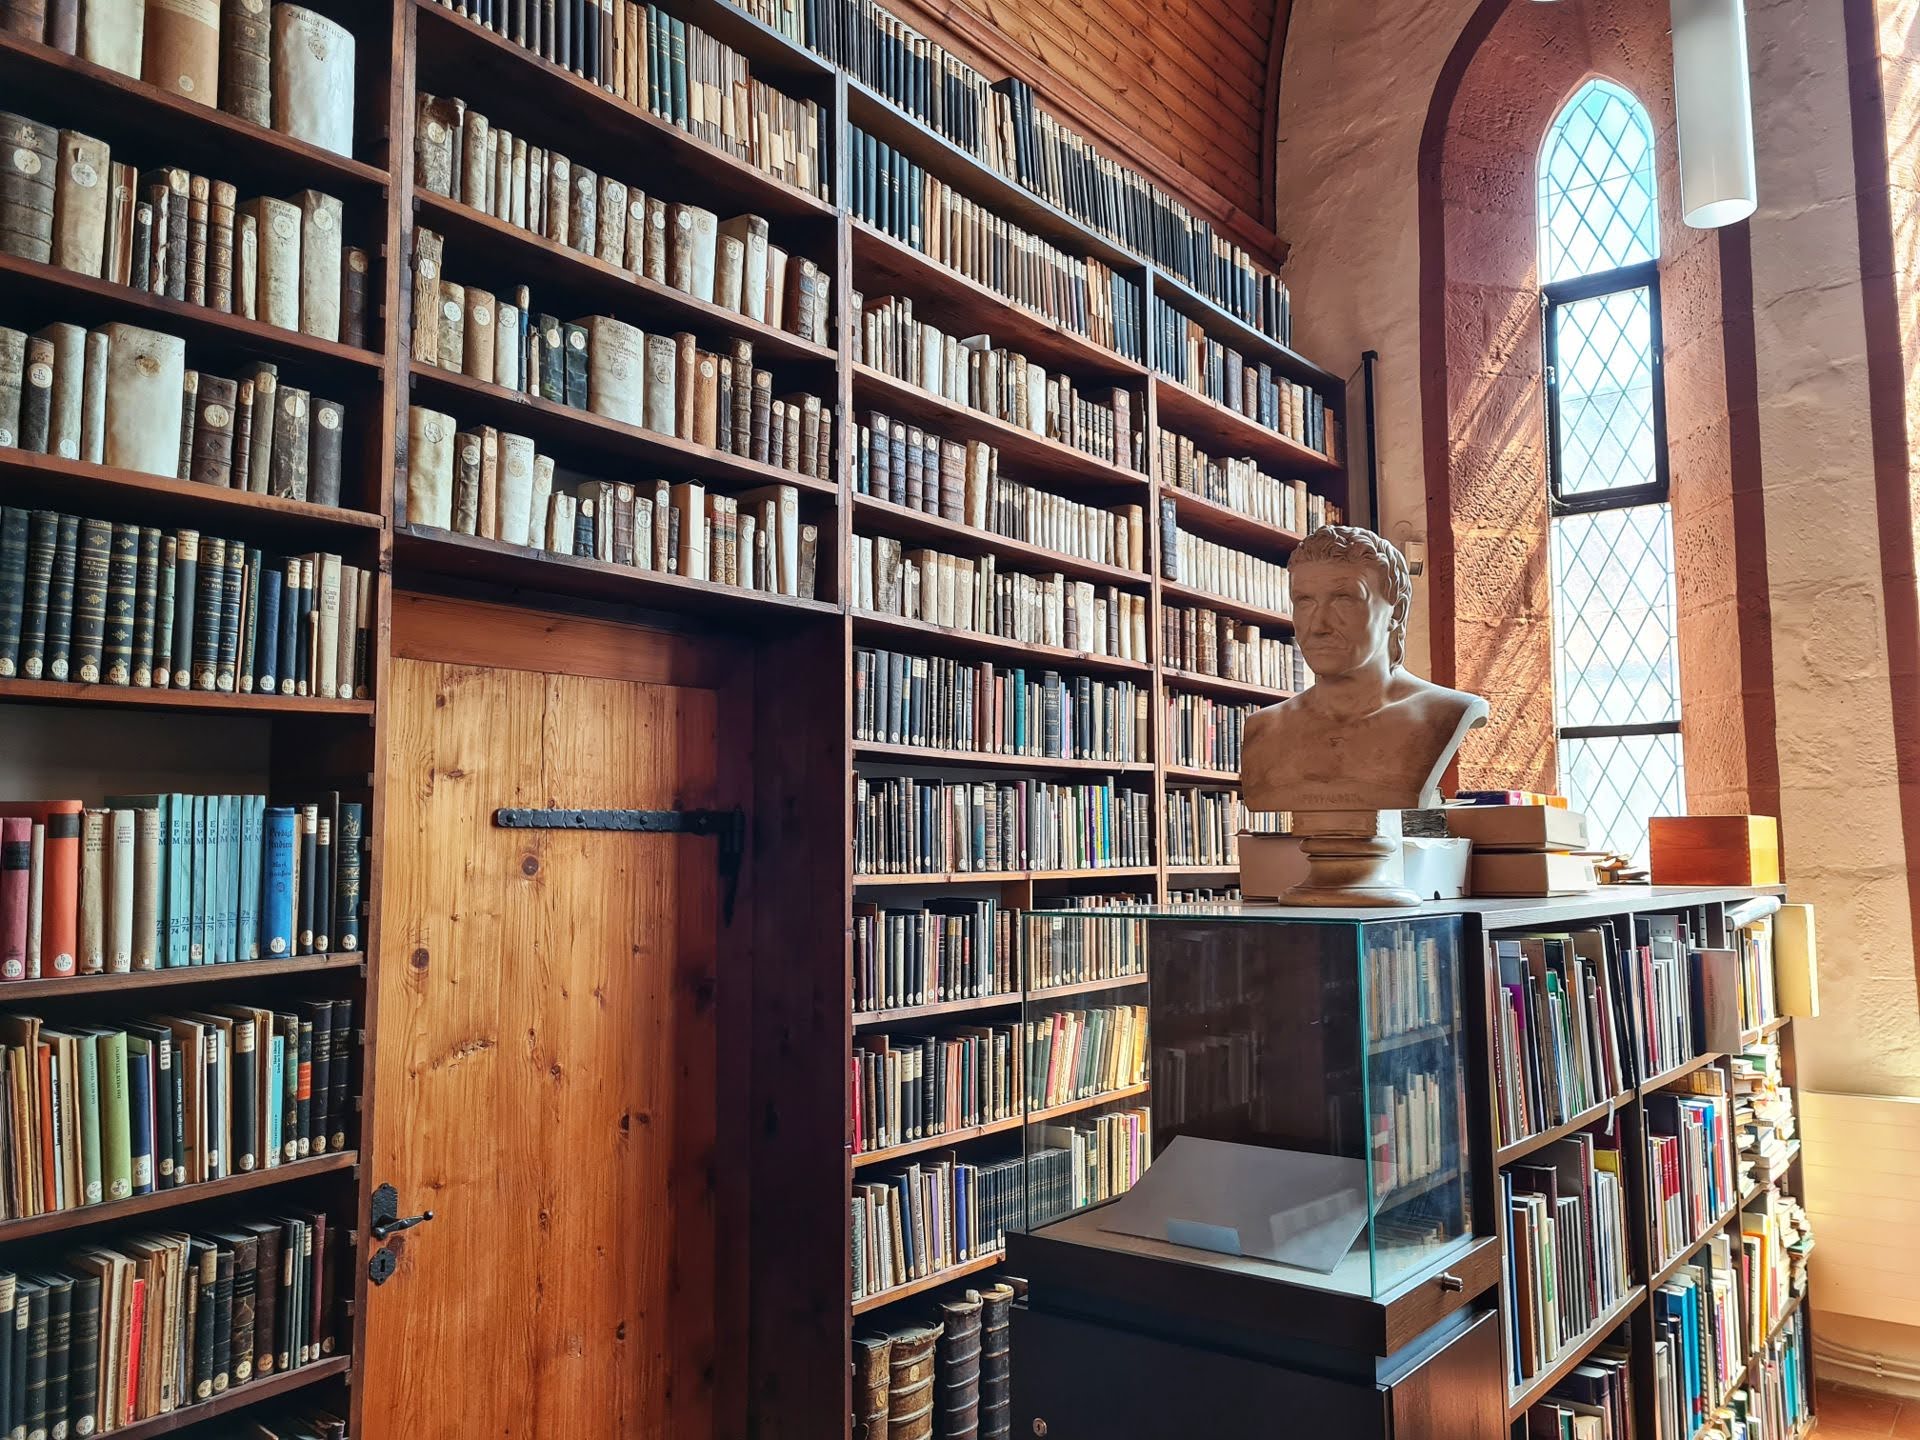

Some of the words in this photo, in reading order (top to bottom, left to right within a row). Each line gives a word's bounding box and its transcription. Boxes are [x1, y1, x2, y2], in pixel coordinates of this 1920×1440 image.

[172, 820, 180, 845] EPM
[183, 821, 191, 846] EPM
[196, 820, 204, 845] EPM
[207, 820, 216, 845] EPM
